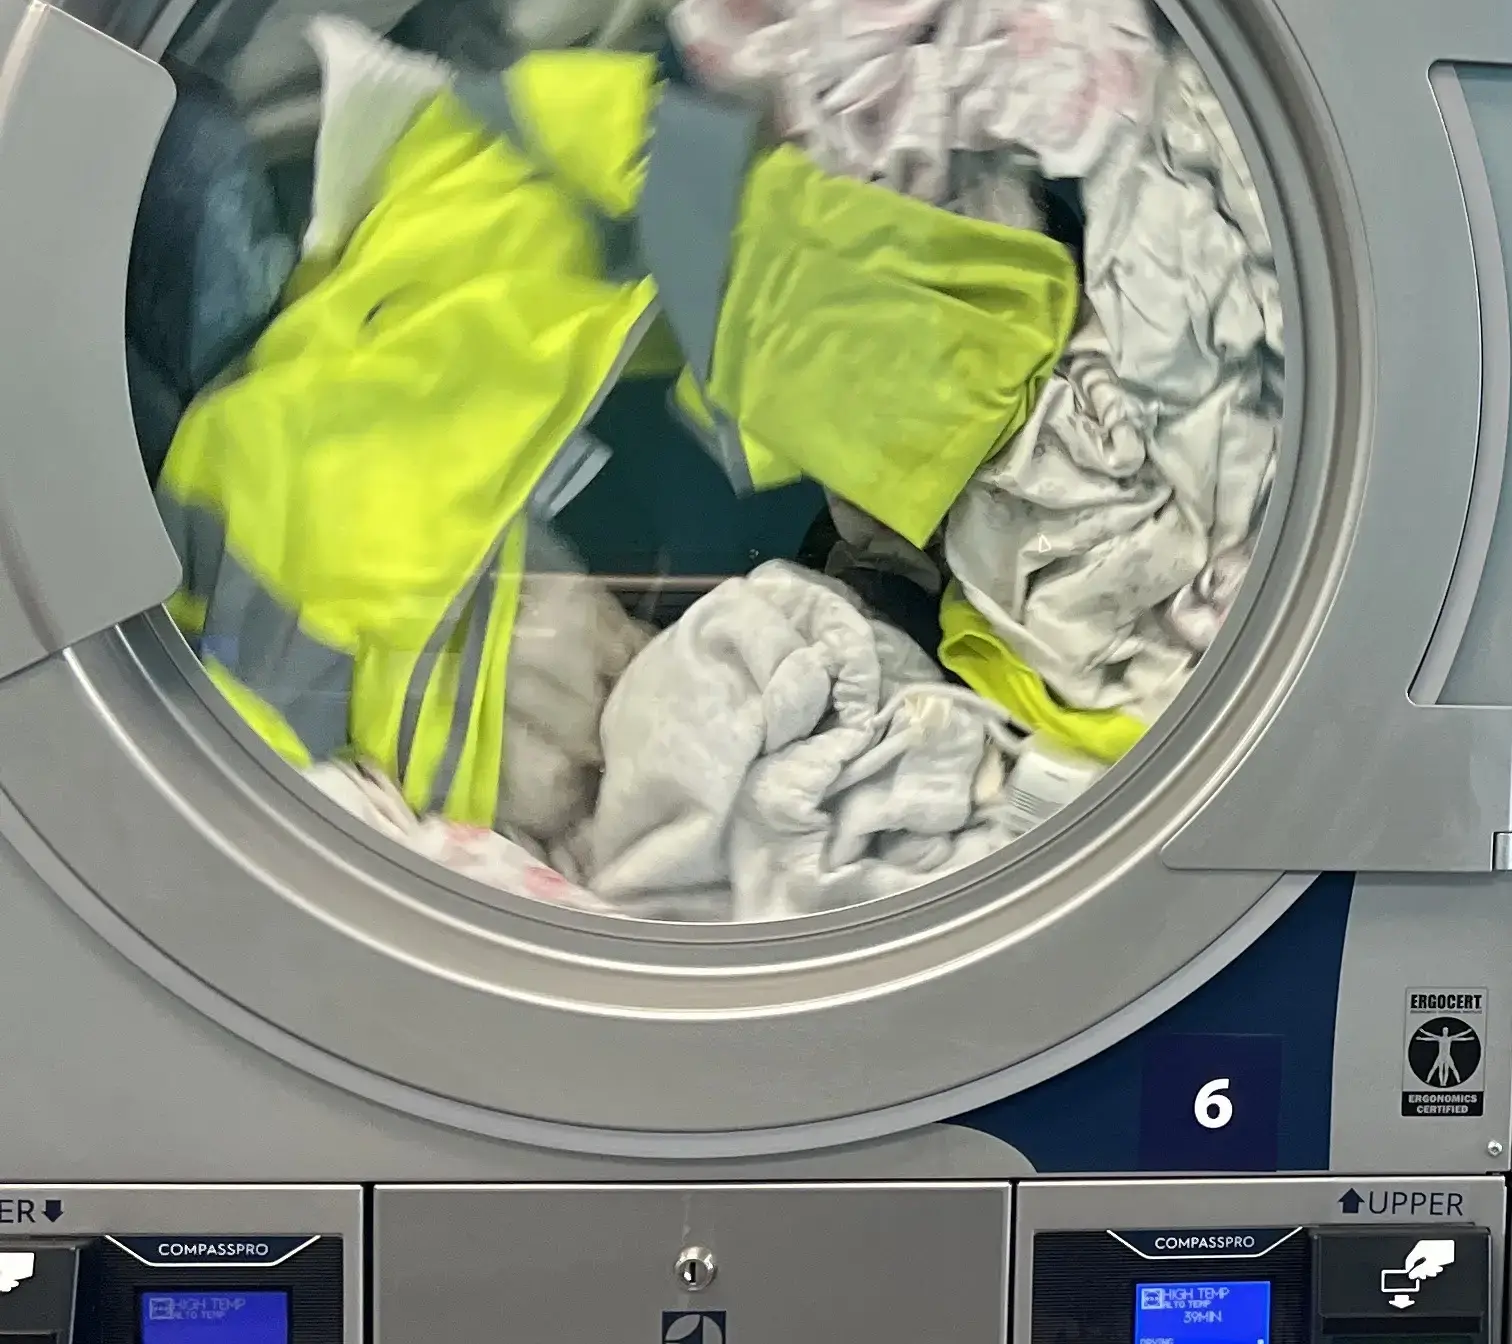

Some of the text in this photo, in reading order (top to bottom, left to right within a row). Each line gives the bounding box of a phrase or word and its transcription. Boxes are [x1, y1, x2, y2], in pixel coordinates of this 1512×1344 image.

[1410, 994, 1482, 1009] ERGOCERT
[1194, 1078, 1233, 1129] 6
[1408, 1094, 1478, 1103] ERGONOMICS
[1416, 1105, 1469, 1114] CERTIFIED
[1368, 1191, 1463, 1216] UPPER
[158, 1242, 269, 1256] COMPASSPRO
[1154, 1235, 1255, 1249] COMPASSPRO
[1164, 1287, 1230, 1300] HIGH TEMP
